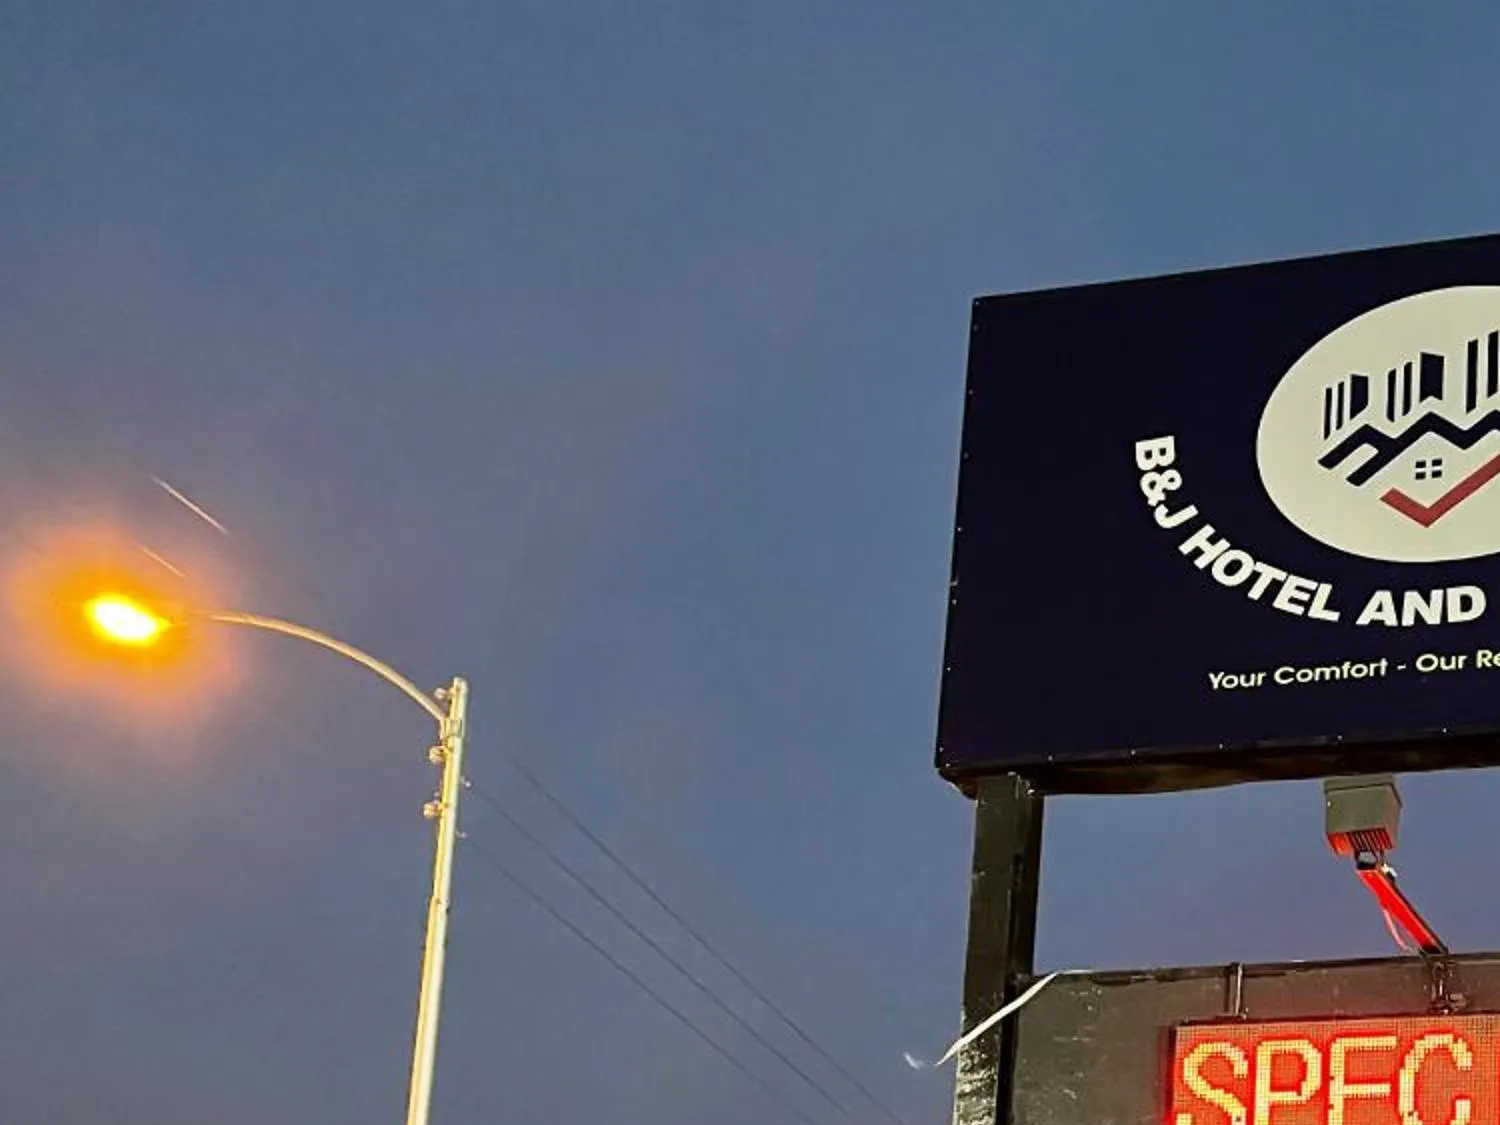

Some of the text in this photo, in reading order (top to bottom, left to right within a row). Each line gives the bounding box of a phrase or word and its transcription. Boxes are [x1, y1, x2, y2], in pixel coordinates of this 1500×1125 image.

[1135, 435, 1199, 529] B&J
[1178, 523, 1341, 622] HOTEL
[1355, 585, 1487, 627] AND
[1208, 670, 1267, 690] Your
[1273, 656, 1389, 685] Comfort
[1415, 651, 1468, 673] Our
